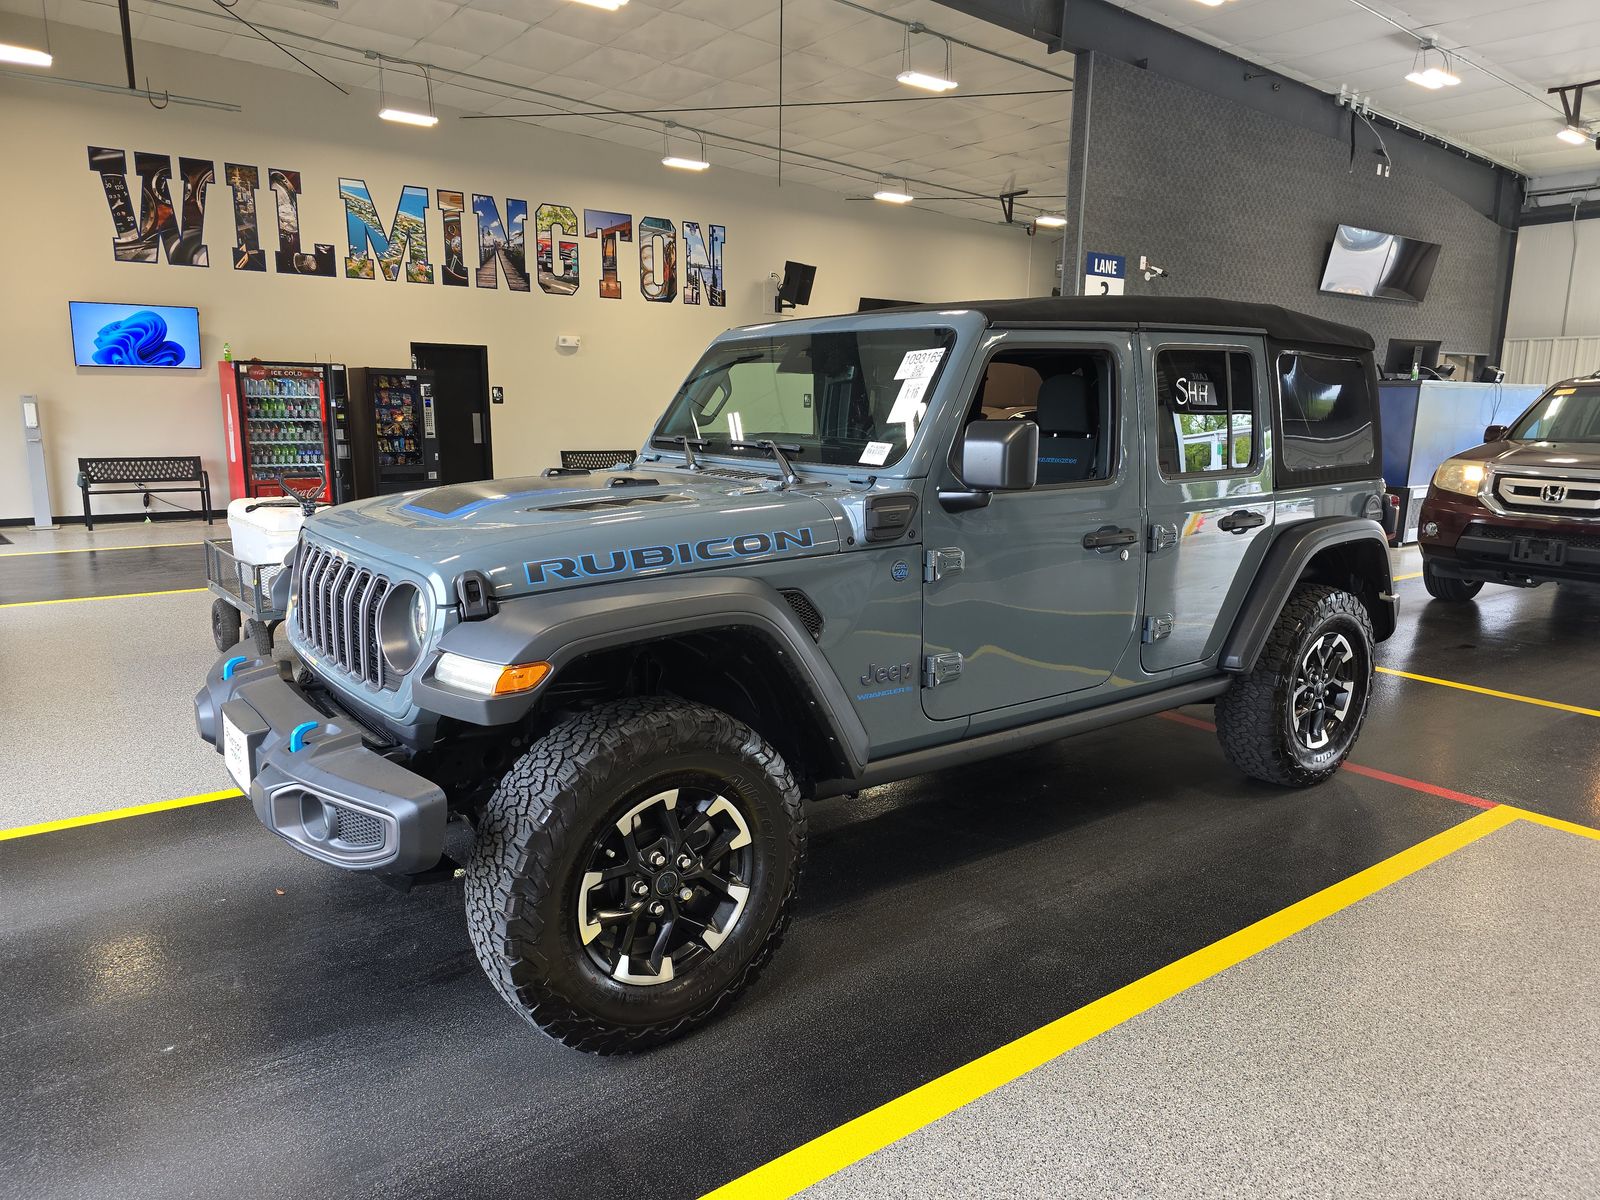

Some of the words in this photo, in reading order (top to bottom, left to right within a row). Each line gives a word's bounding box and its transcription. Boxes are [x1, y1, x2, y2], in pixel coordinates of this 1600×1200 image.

[87, 145, 727, 307] WILMINGTON
[1094, 258, 1117, 275] LANE
[905, 351, 943, 365] 1093165
[1176, 377, 1208, 405] SHH
[523, 527, 813, 585] RUBICON
[861, 663, 911, 686] Jeep
[857, 687, 905, 701] WRANGLER
